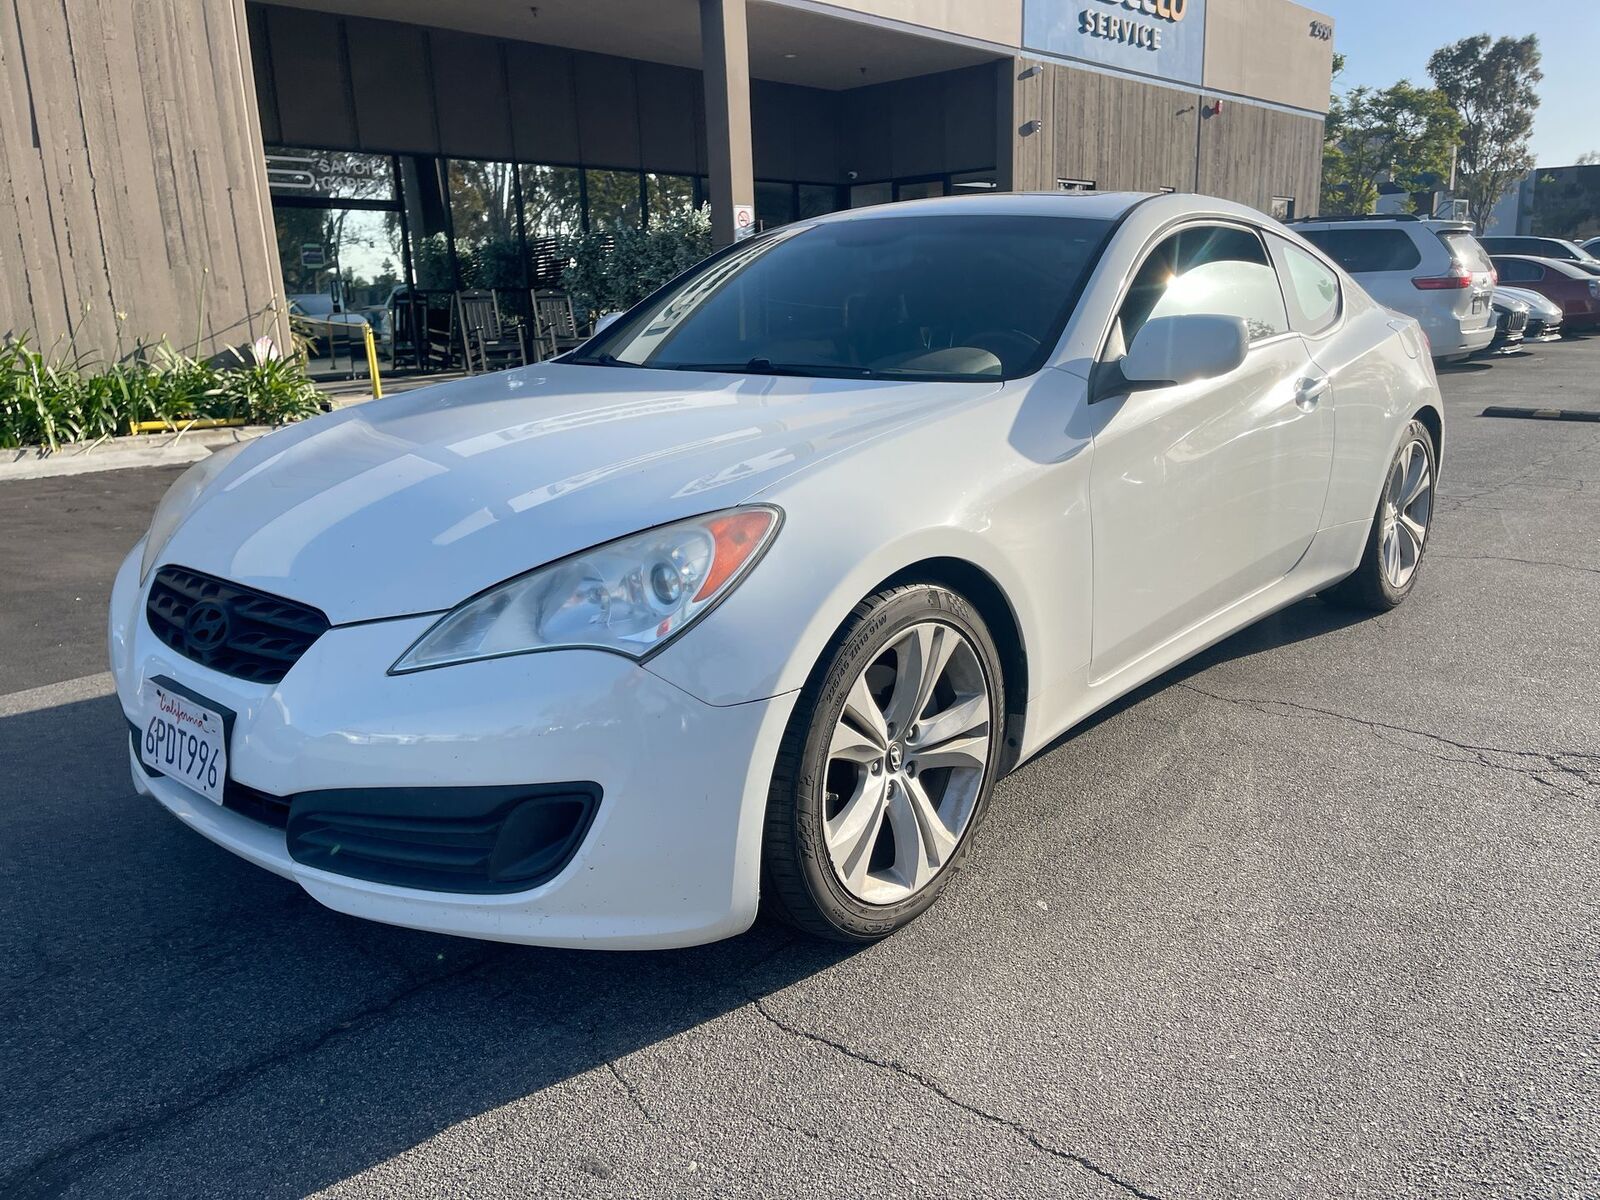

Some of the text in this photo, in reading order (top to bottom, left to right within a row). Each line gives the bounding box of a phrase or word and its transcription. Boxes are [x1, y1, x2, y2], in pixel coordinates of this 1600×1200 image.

[1083, 8, 1162, 49] SERVICE
[159, 693, 205, 729] California
[145, 716, 219, 789] 6PDT996
